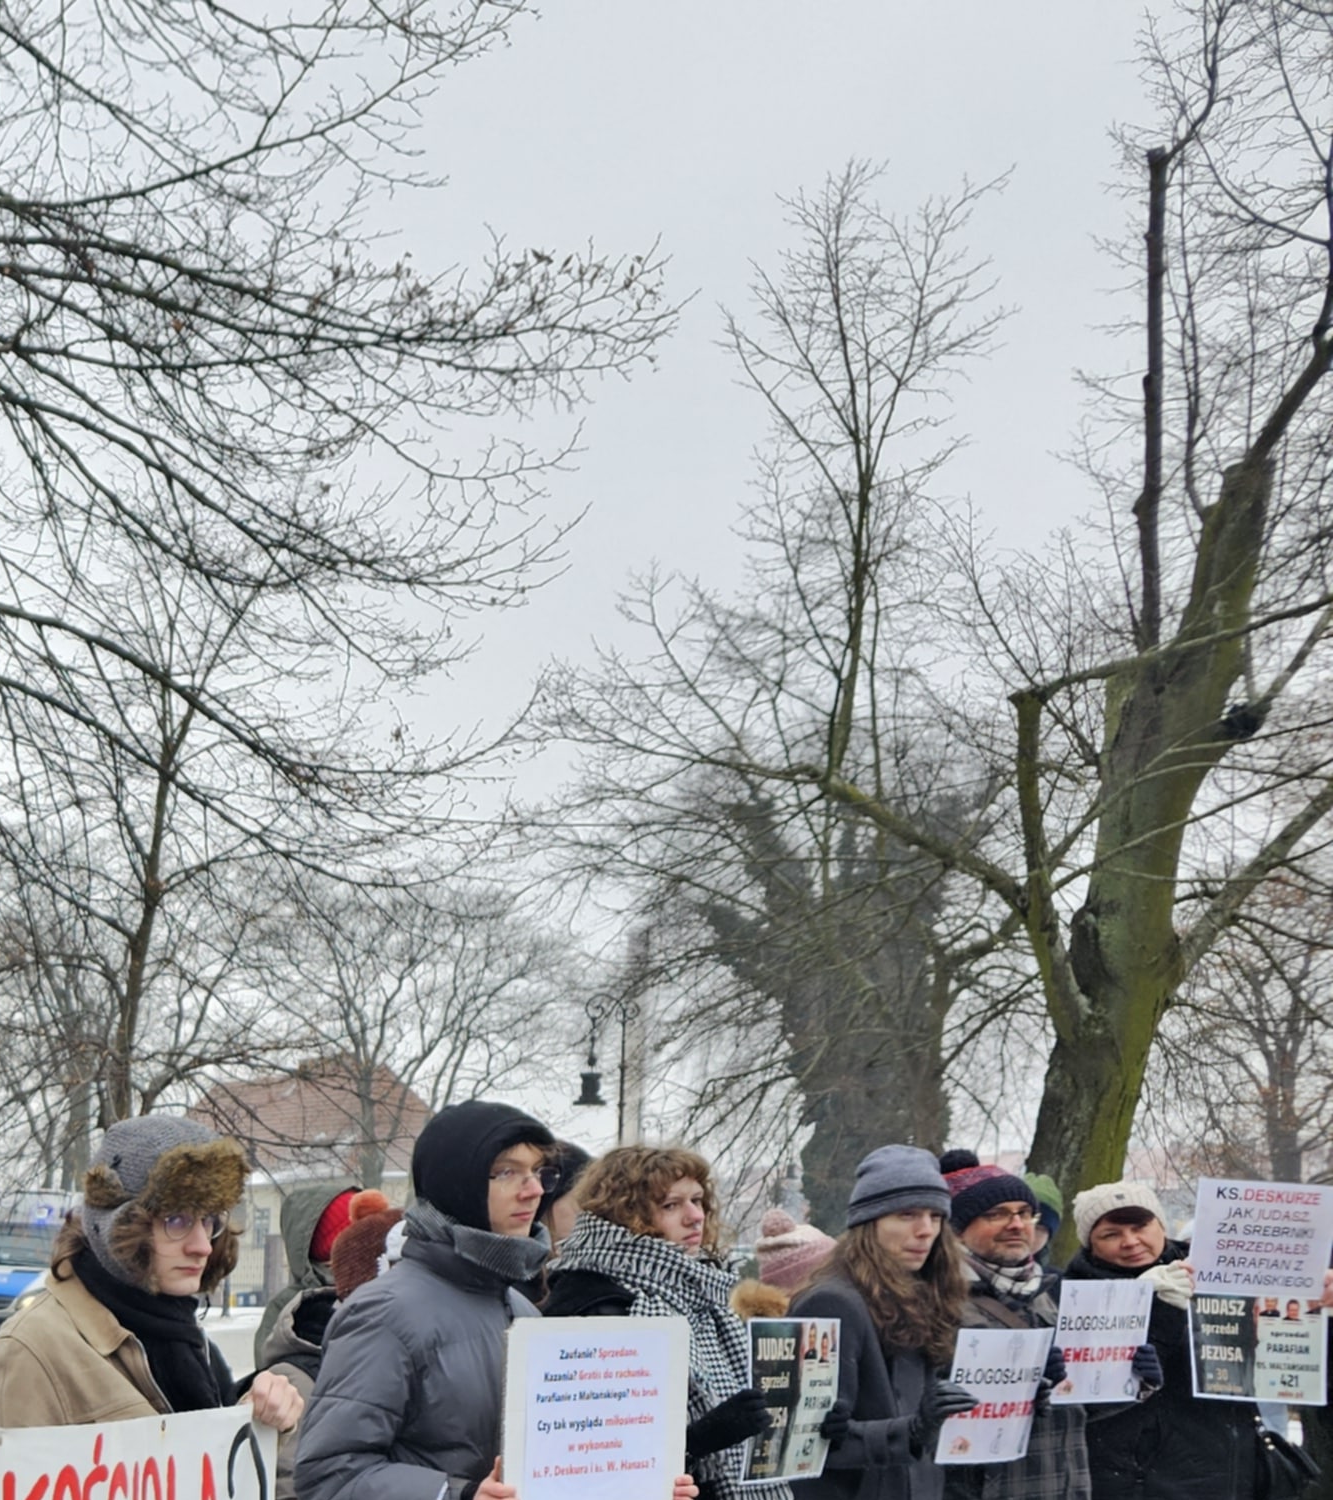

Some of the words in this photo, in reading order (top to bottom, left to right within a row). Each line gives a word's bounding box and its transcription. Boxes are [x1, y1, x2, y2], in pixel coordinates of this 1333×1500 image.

[1225, 1207, 1253, 1220] JAK
[1255, 1209, 1311, 1223] JUDASZ
[1216, 1222, 1238, 1235] ZA
[1216, 1239, 1310, 1256] SPRZEDAŁEŚ
[1216, 1255, 1290, 1270] PARAFIAN
[1293, 1260, 1304, 1272] Z
[1197, 1270, 1314, 1289] MALTAŃSKIEGO
[1195, 1297, 1246, 1316] JUDASZ
[559, 1347, 597, 1360] Zaufanie?
[757, 1337, 796, 1361] JUDASZ
[1062, 1345, 1137, 1363] EWELOPERZ
[1200, 1344, 1244, 1362] JEZUSA
[544, 1370, 578, 1382] Kazania?
[603, 1368, 612, 1379] do
[536, 1391, 571, 1403] Parafianie
[537, 1420, 551, 1434] Czy
[553, 1417, 566, 1430] tak
[568, 1416, 603, 1432] wygląda
[577, 1437, 623, 1454] wykonaniu
